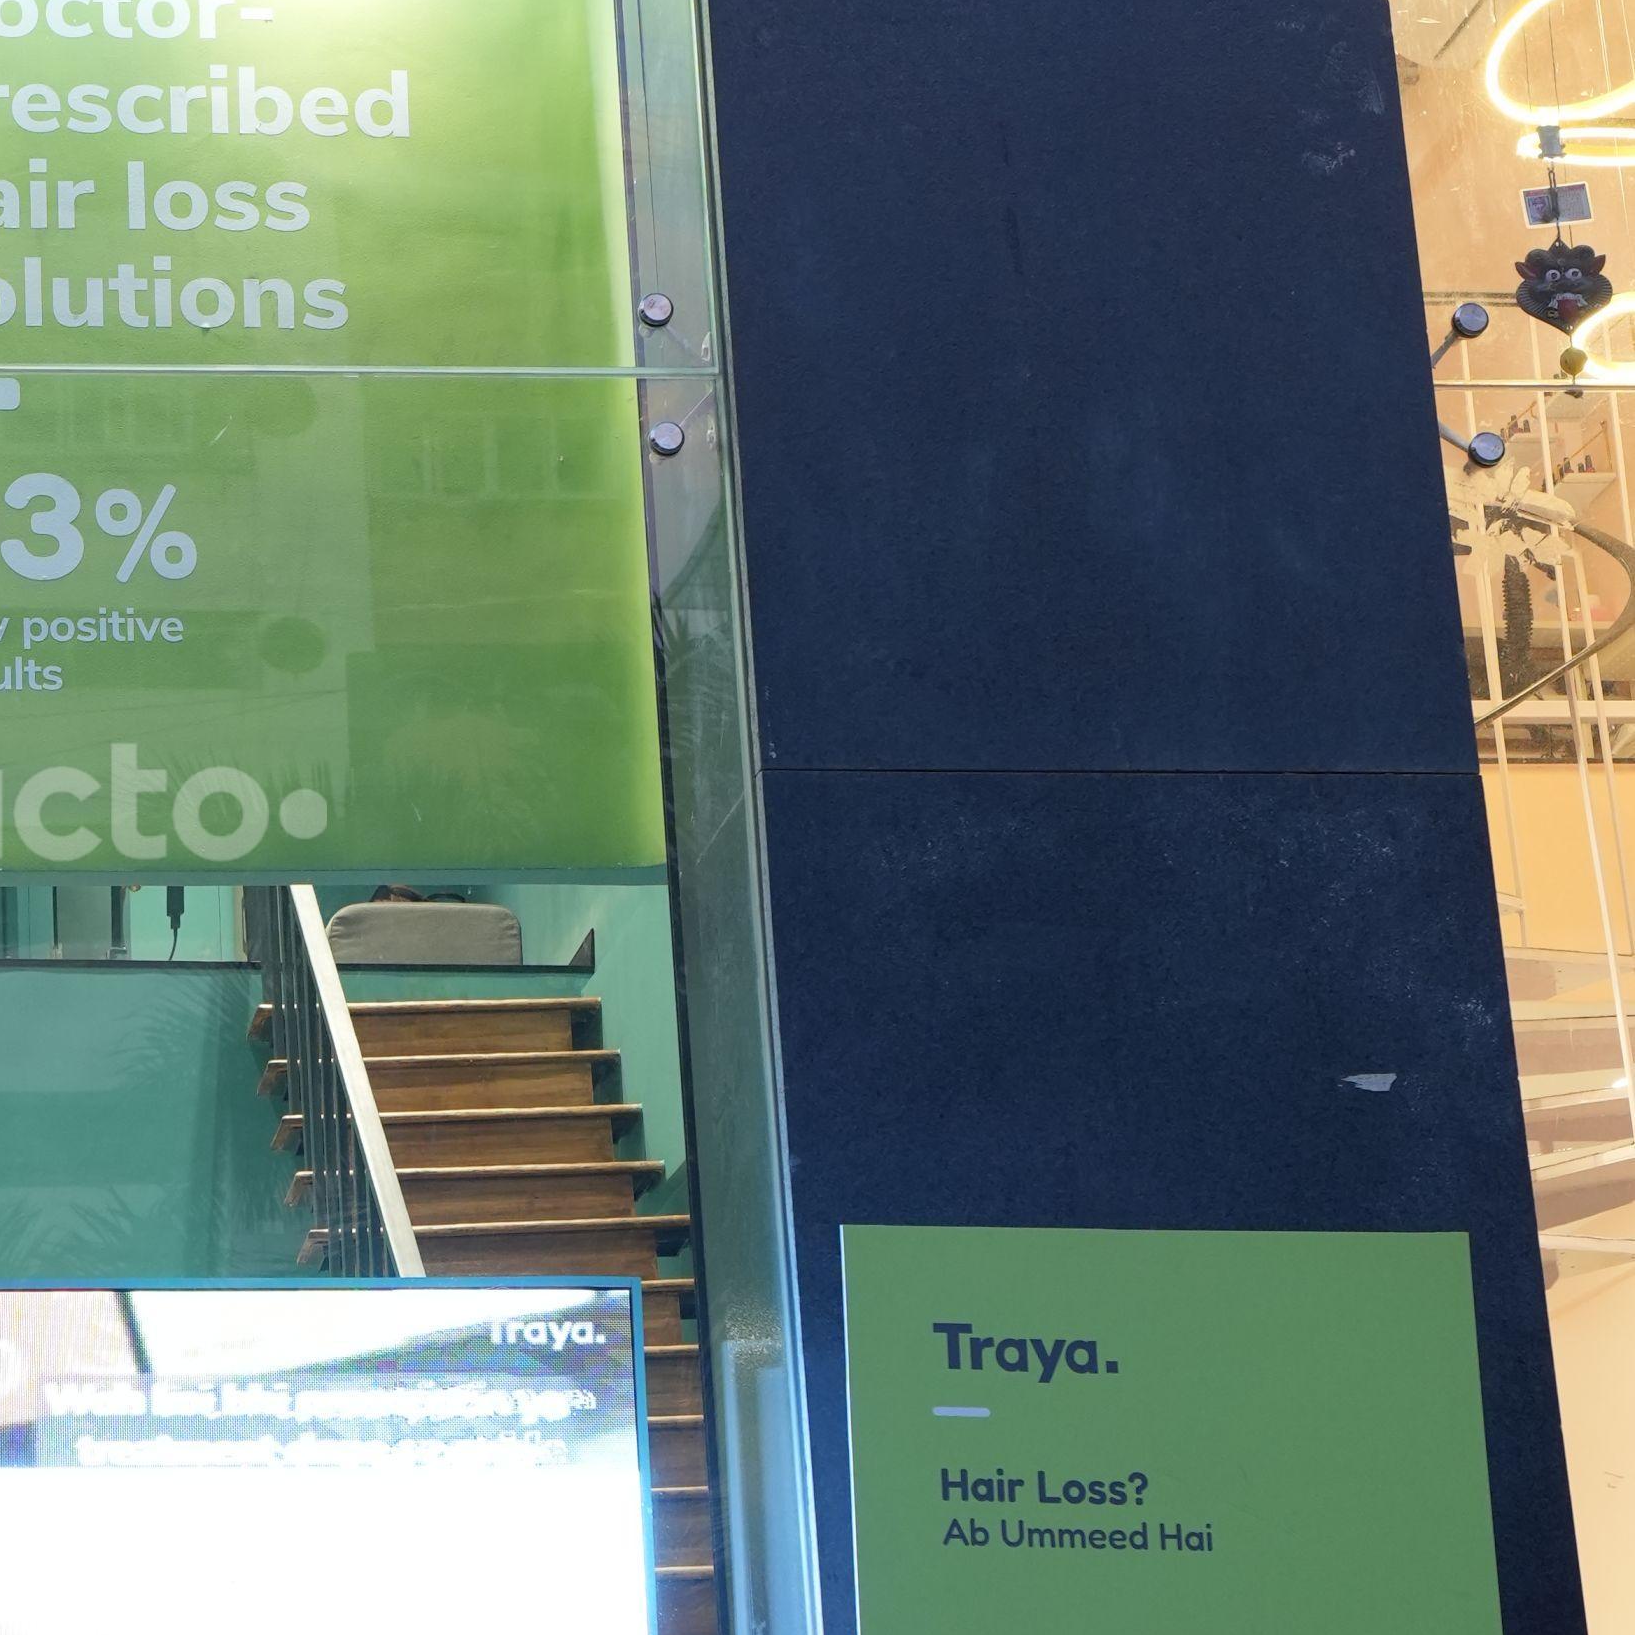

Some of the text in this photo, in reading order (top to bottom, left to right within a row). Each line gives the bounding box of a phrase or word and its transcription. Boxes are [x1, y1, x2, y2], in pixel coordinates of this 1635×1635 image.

[128, 161, 311, 232] loss
[22, 607, 184, 649] positive
[932, 1322, 1120, 1383] Traya.
[941, 1468, 1149, 1505] Hair Loss?
[942, 1518, 1214, 1552] Ab Ummeed Hai
